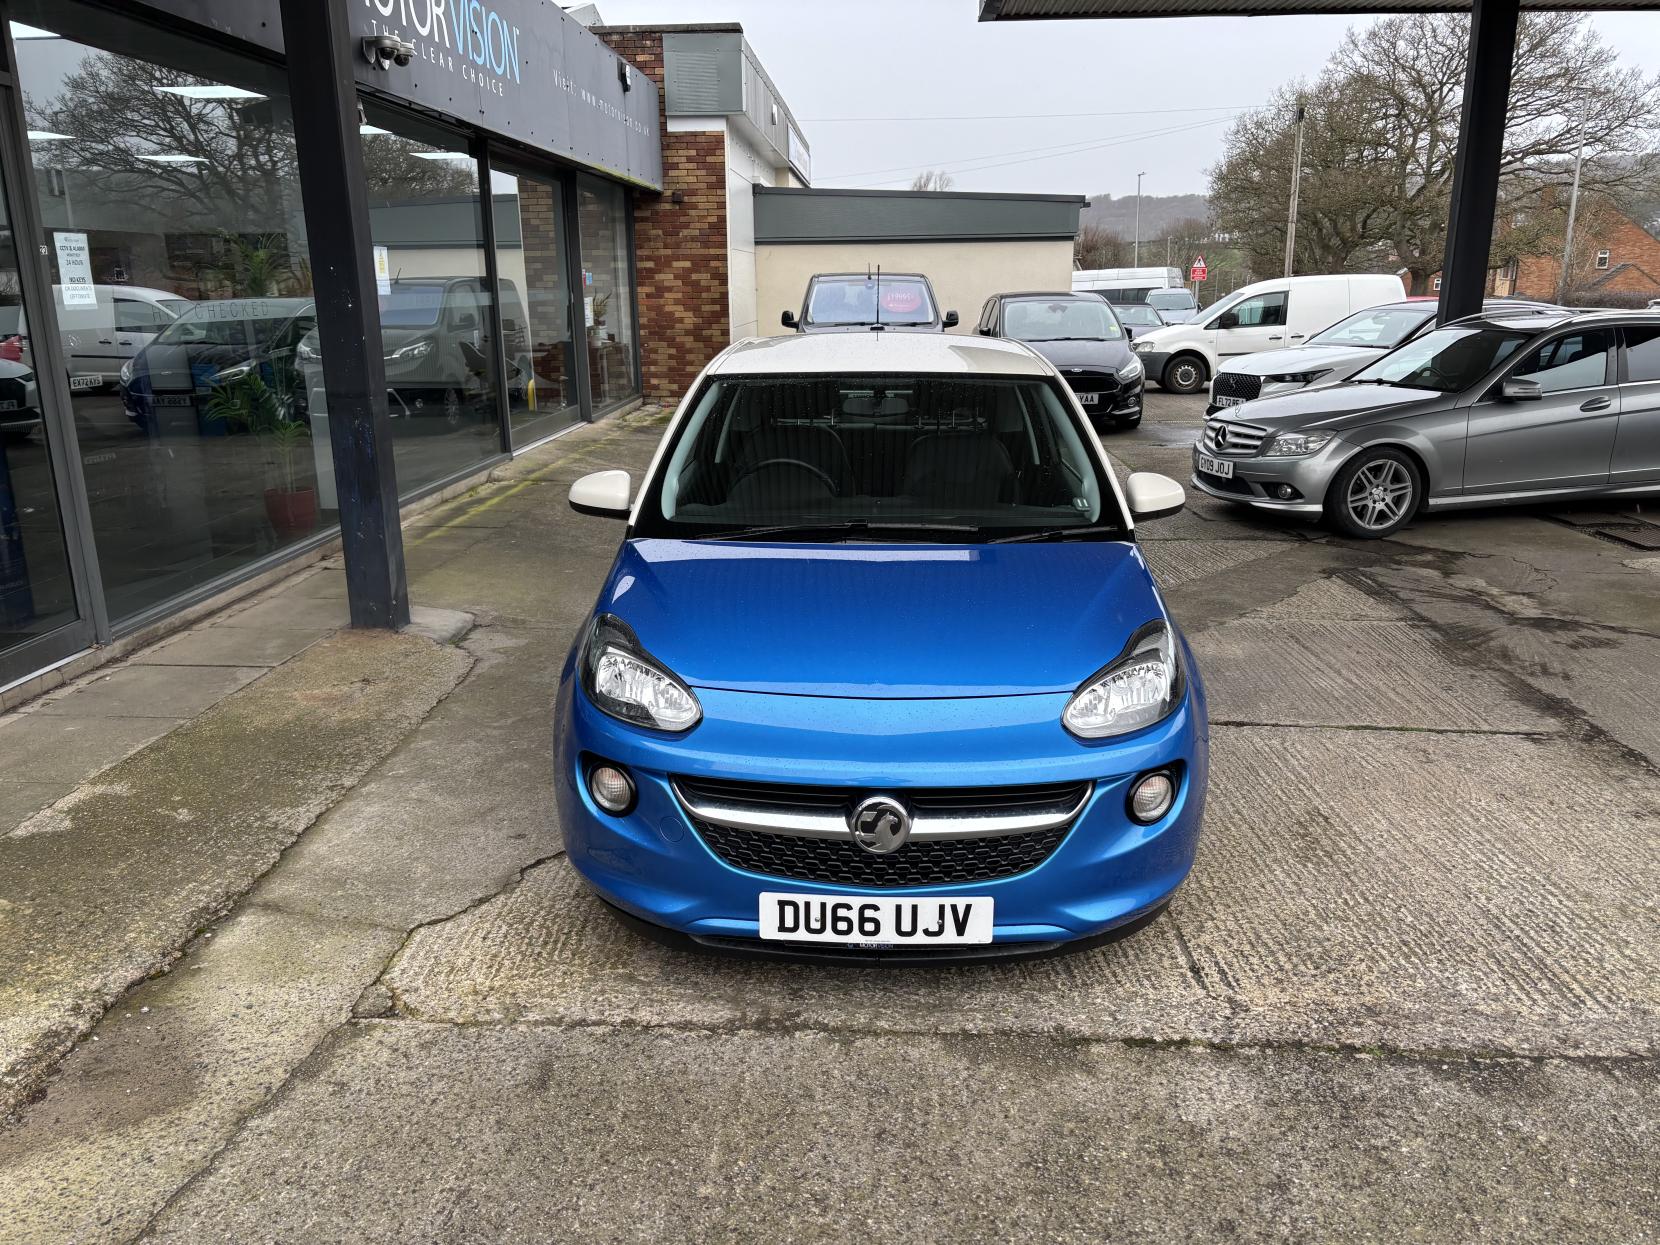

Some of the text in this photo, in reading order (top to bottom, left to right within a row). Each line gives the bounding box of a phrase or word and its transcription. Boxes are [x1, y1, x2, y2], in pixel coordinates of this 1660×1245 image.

[462, 64, 503, 97] CHOICE
[194, 301, 270, 320] CHECKED
[1079, 394, 1095, 403] YAA
[1218, 397, 1232, 407] FL72
[1215, 461, 1230, 475] JOJ
[777, 899, 973, 937] DU66 UJV
